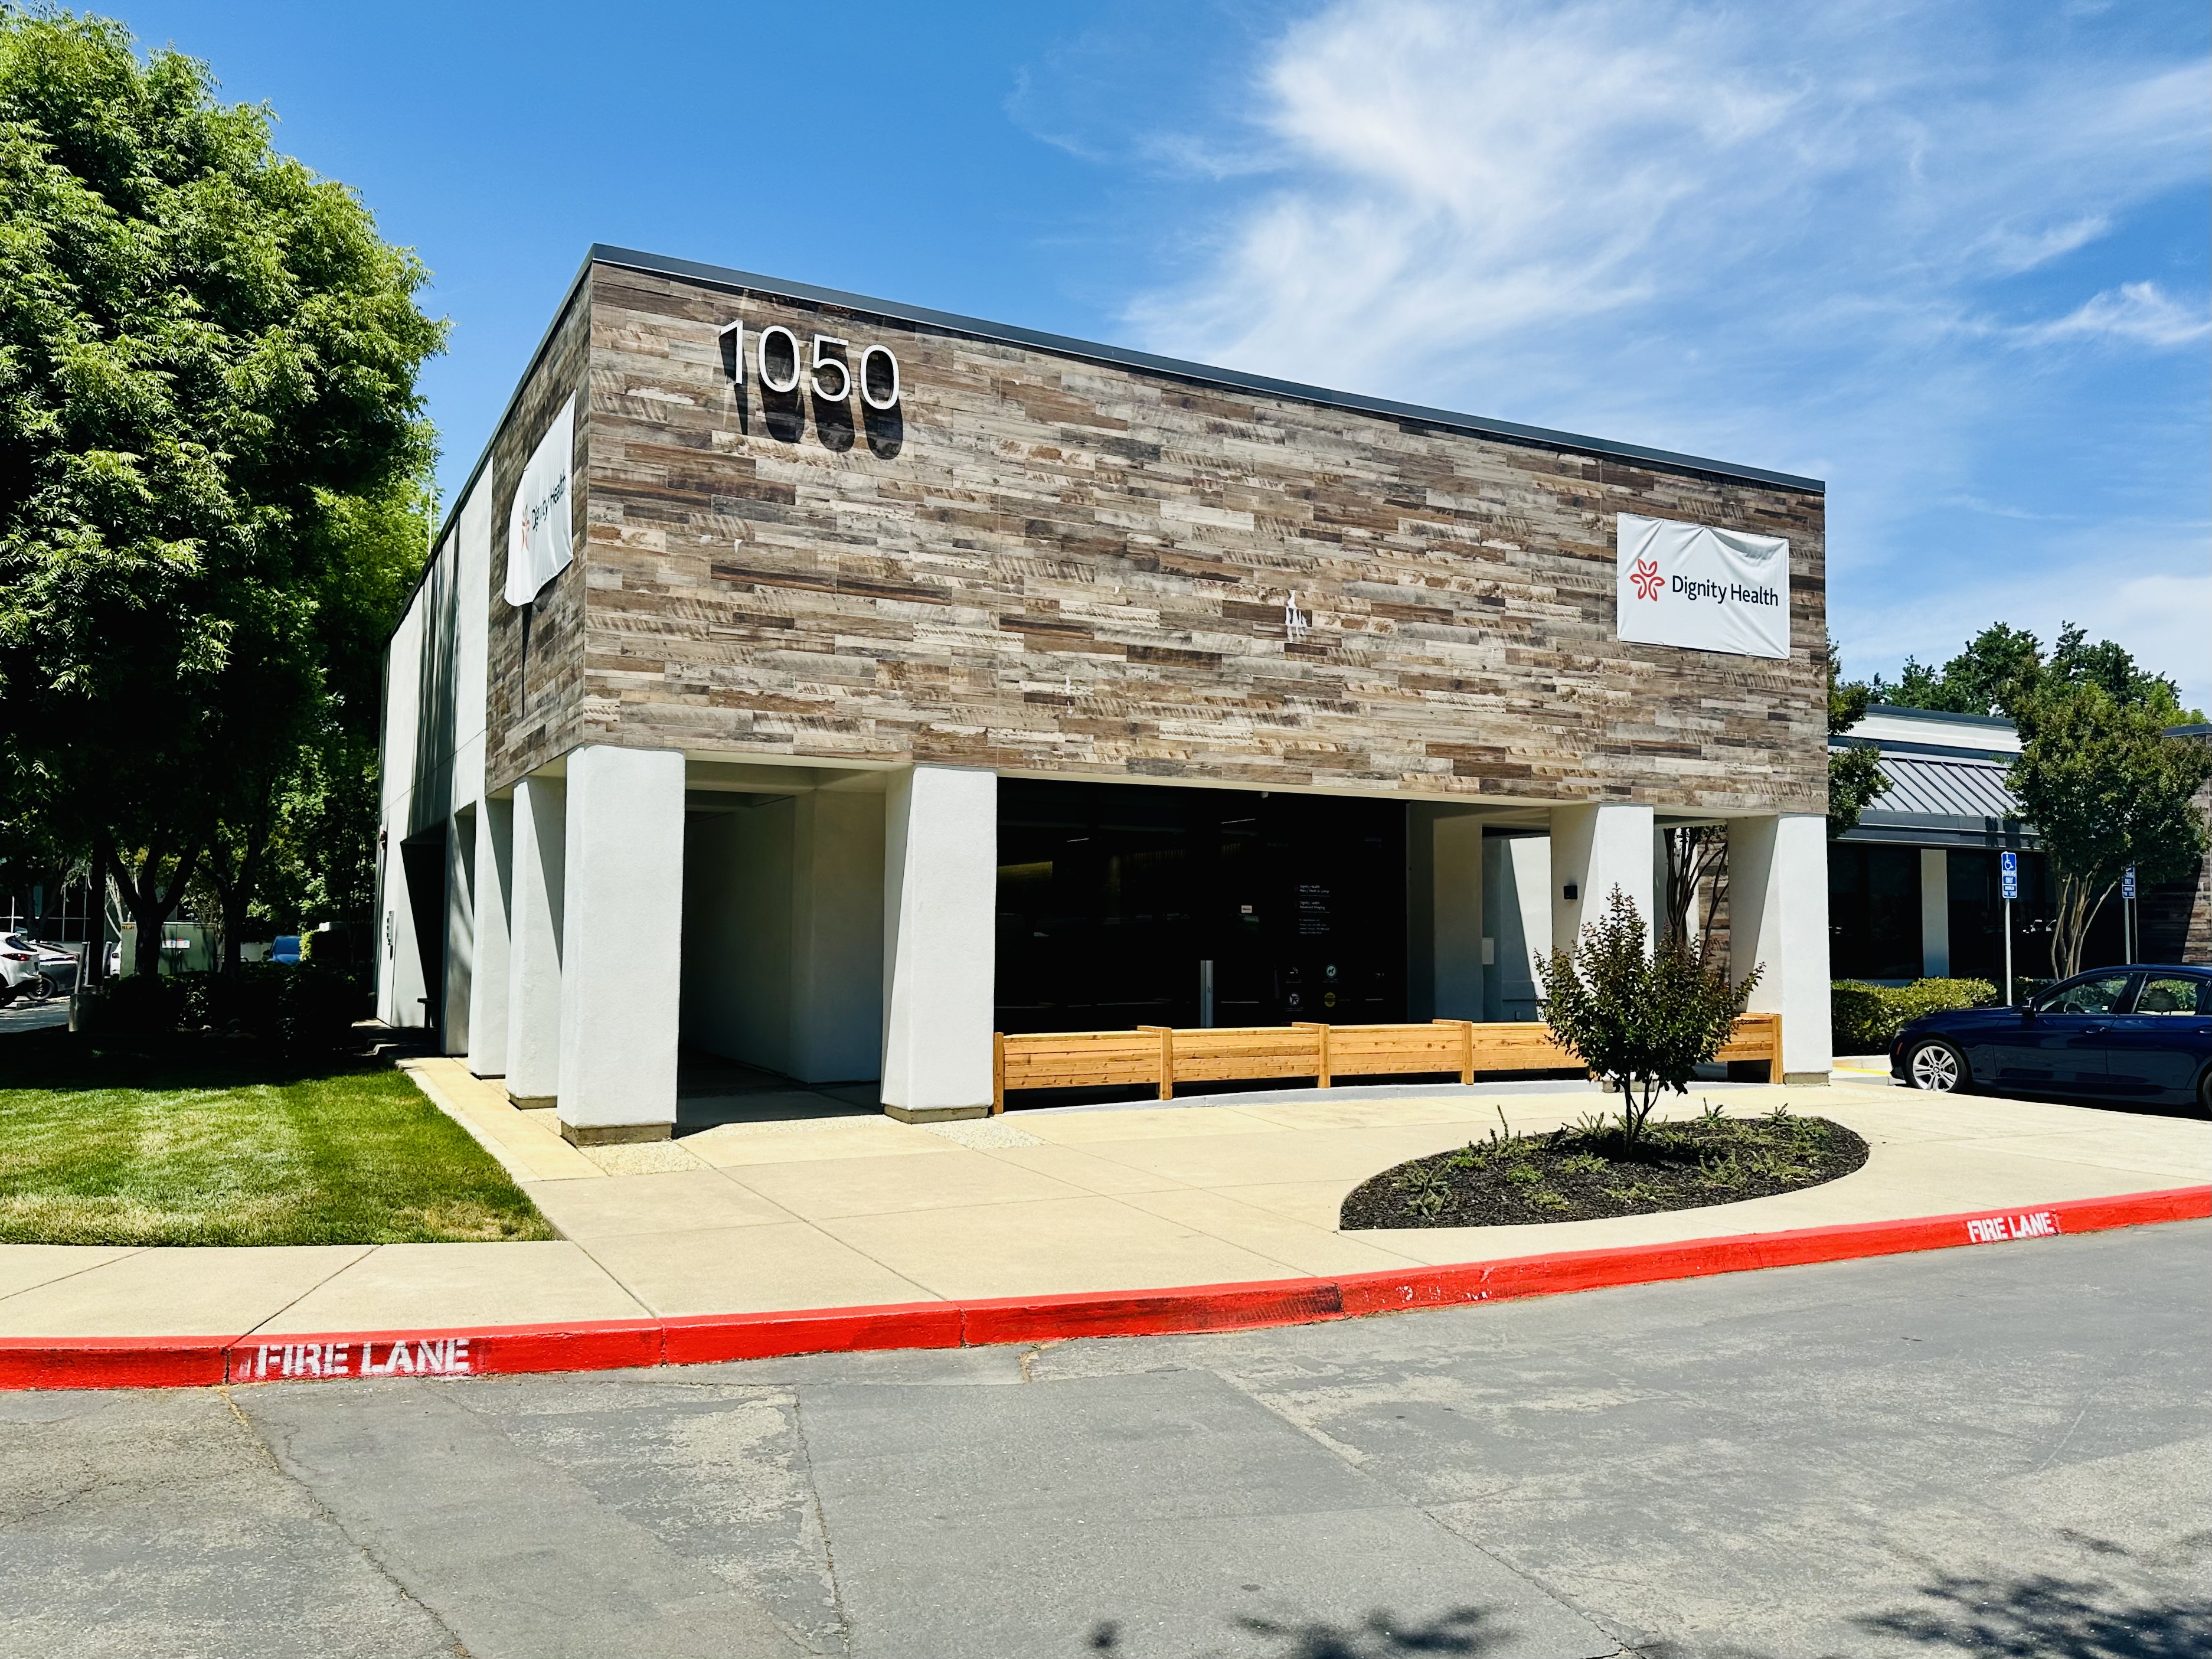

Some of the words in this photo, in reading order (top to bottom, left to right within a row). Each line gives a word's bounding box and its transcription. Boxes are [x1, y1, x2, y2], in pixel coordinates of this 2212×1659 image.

[720, 320, 900, 410] 1050
[532, 497, 549, 532] Dignity
[550, 468, 566, 510] Health
[1672, 575, 1727, 604] Dignity
[1731, 583, 1779, 606] Health
[1967, 1217, 2008, 1242] FIRE
[2008, 1211, 2055, 1238] LANE
[256, 1342, 349, 1376] FIRE
[360, 1338, 471, 1374] LANE
